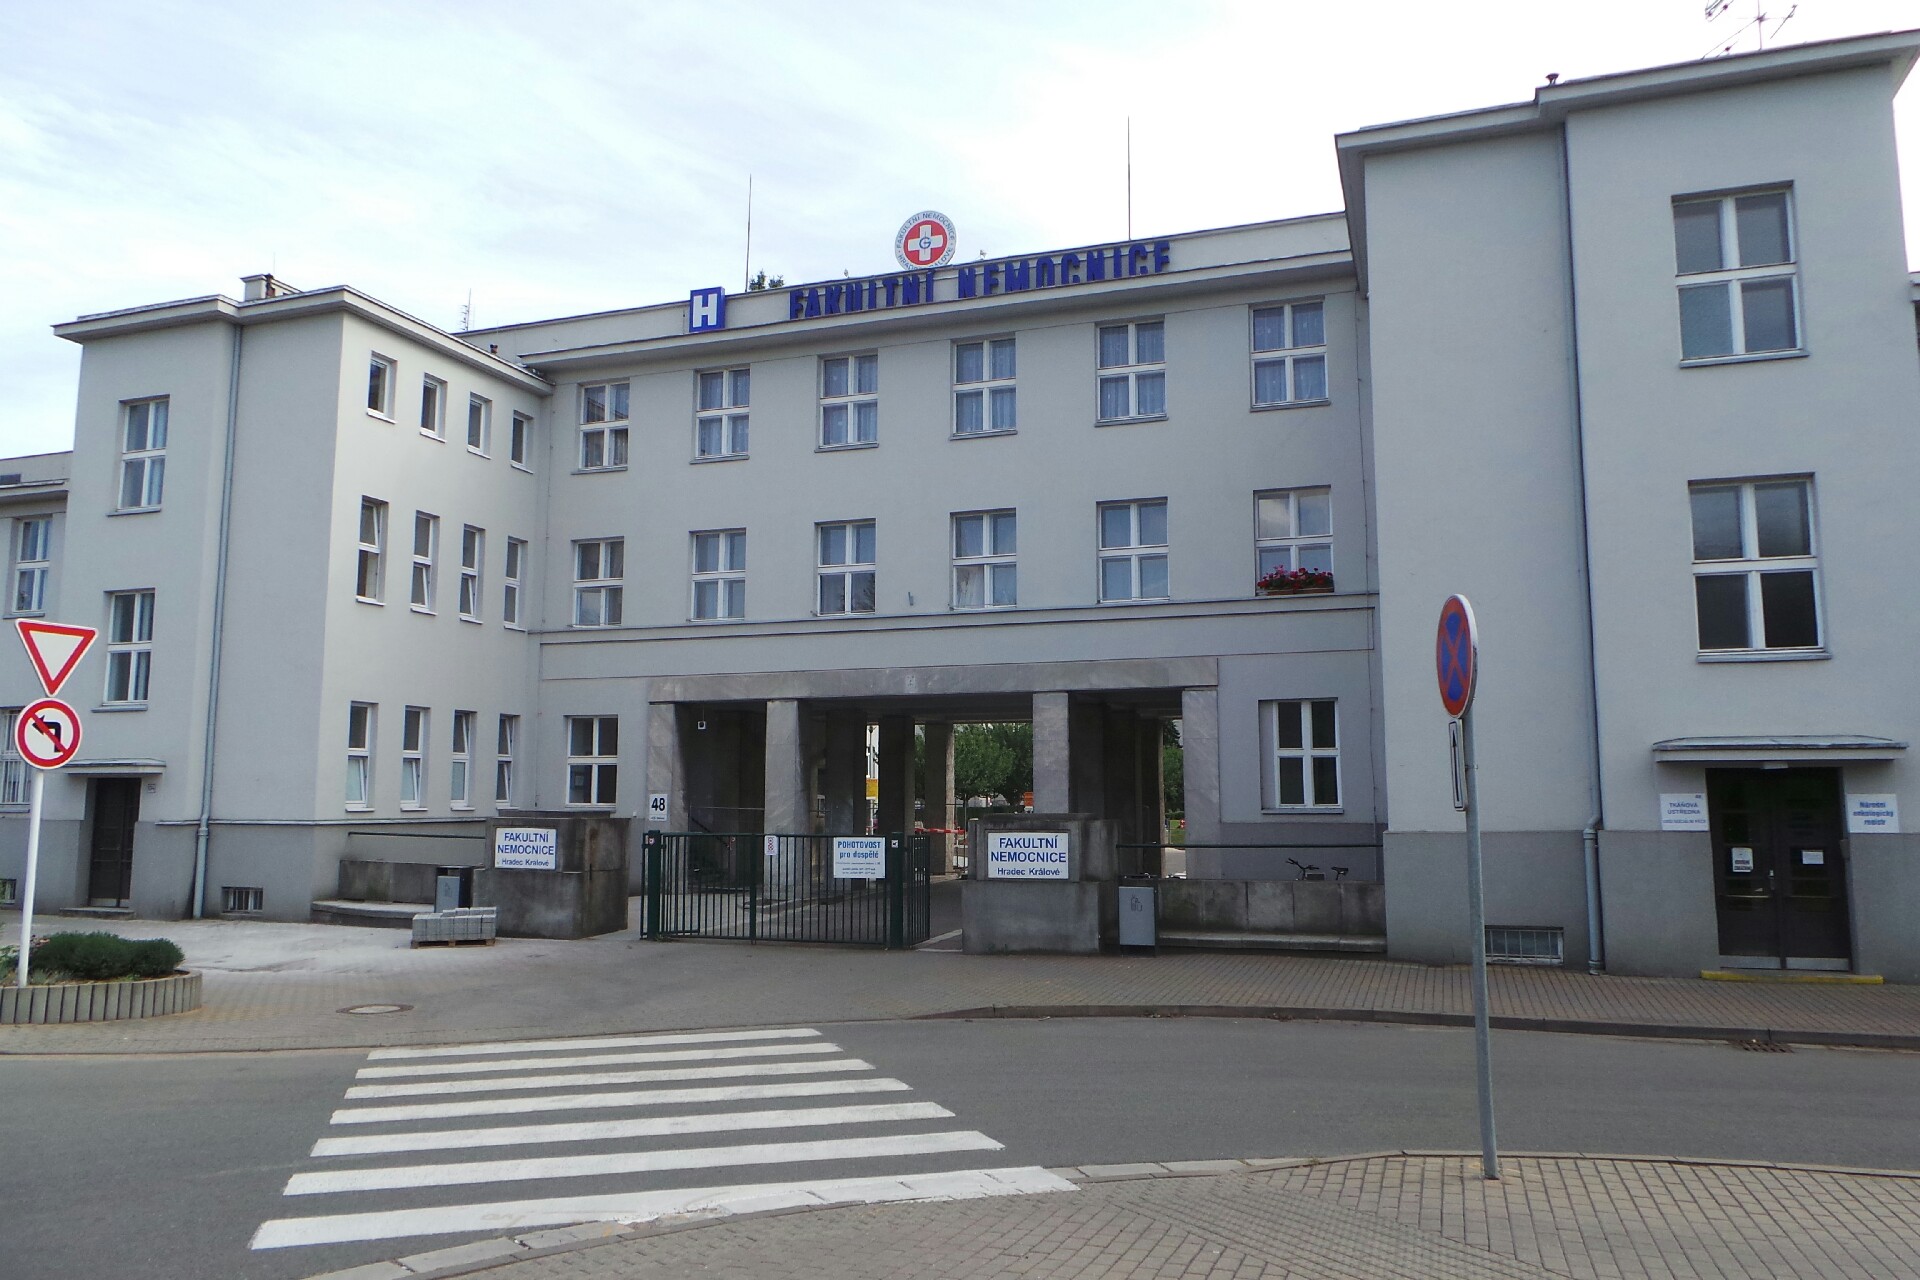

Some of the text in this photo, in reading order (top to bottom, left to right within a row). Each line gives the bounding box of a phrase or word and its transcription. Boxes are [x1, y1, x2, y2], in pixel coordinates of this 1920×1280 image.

[957, 241, 1170, 299] NEMOCNICE
[692, 294, 718, 329] H
[651, 797, 665, 811] 48
[504, 830, 549, 843] FAKULTNÍ
[999, 834, 1058, 849] FAKULTNÍ
[497, 844, 555, 856] NEMOCNICE
[837, 840, 881, 848] POHOTOVOST
[840, 850, 879, 860] pro dospělé
[991, 852, 1066, 863] NEMOCNICE
[502, 858, 523, 866] Hradec
[997, 866, 1061, 876] Hradec Králové
